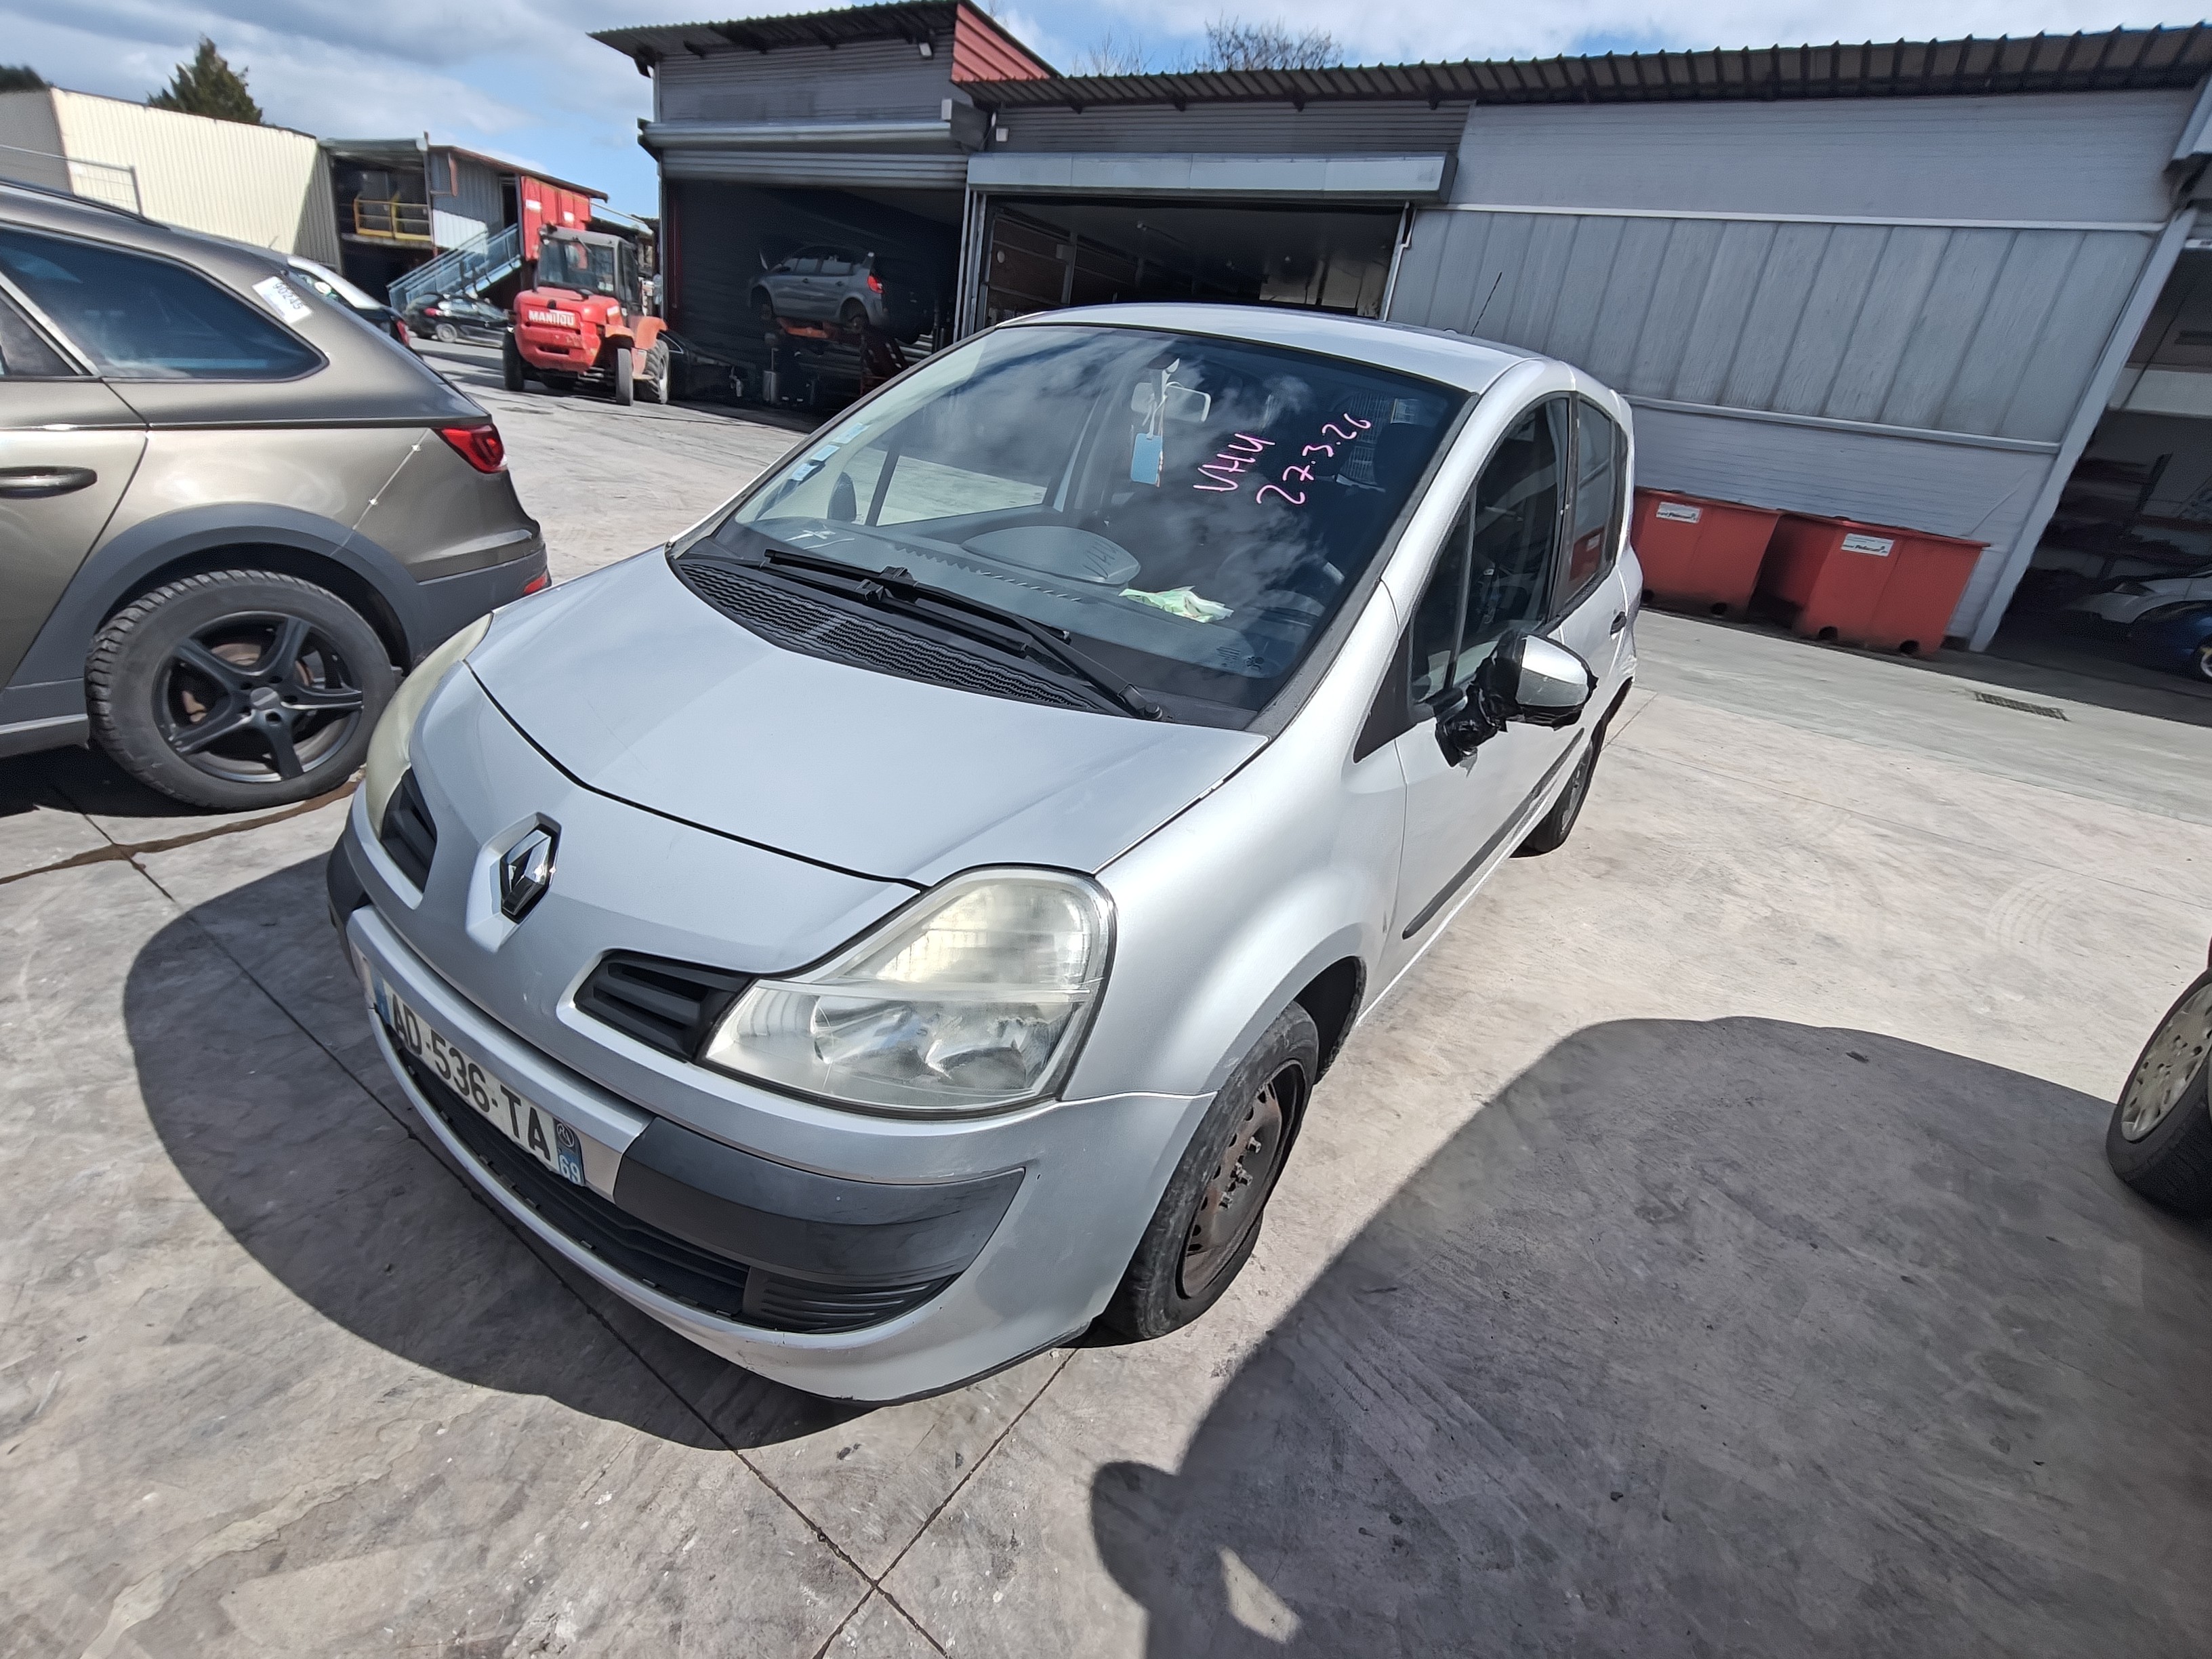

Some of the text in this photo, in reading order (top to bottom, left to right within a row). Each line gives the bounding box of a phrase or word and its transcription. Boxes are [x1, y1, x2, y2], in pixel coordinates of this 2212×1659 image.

[529, 309, 575, 326] MANITOU
[1256, 413, 1372, 505] 27.3.26
[559, 1154, 581, 1183] 69
